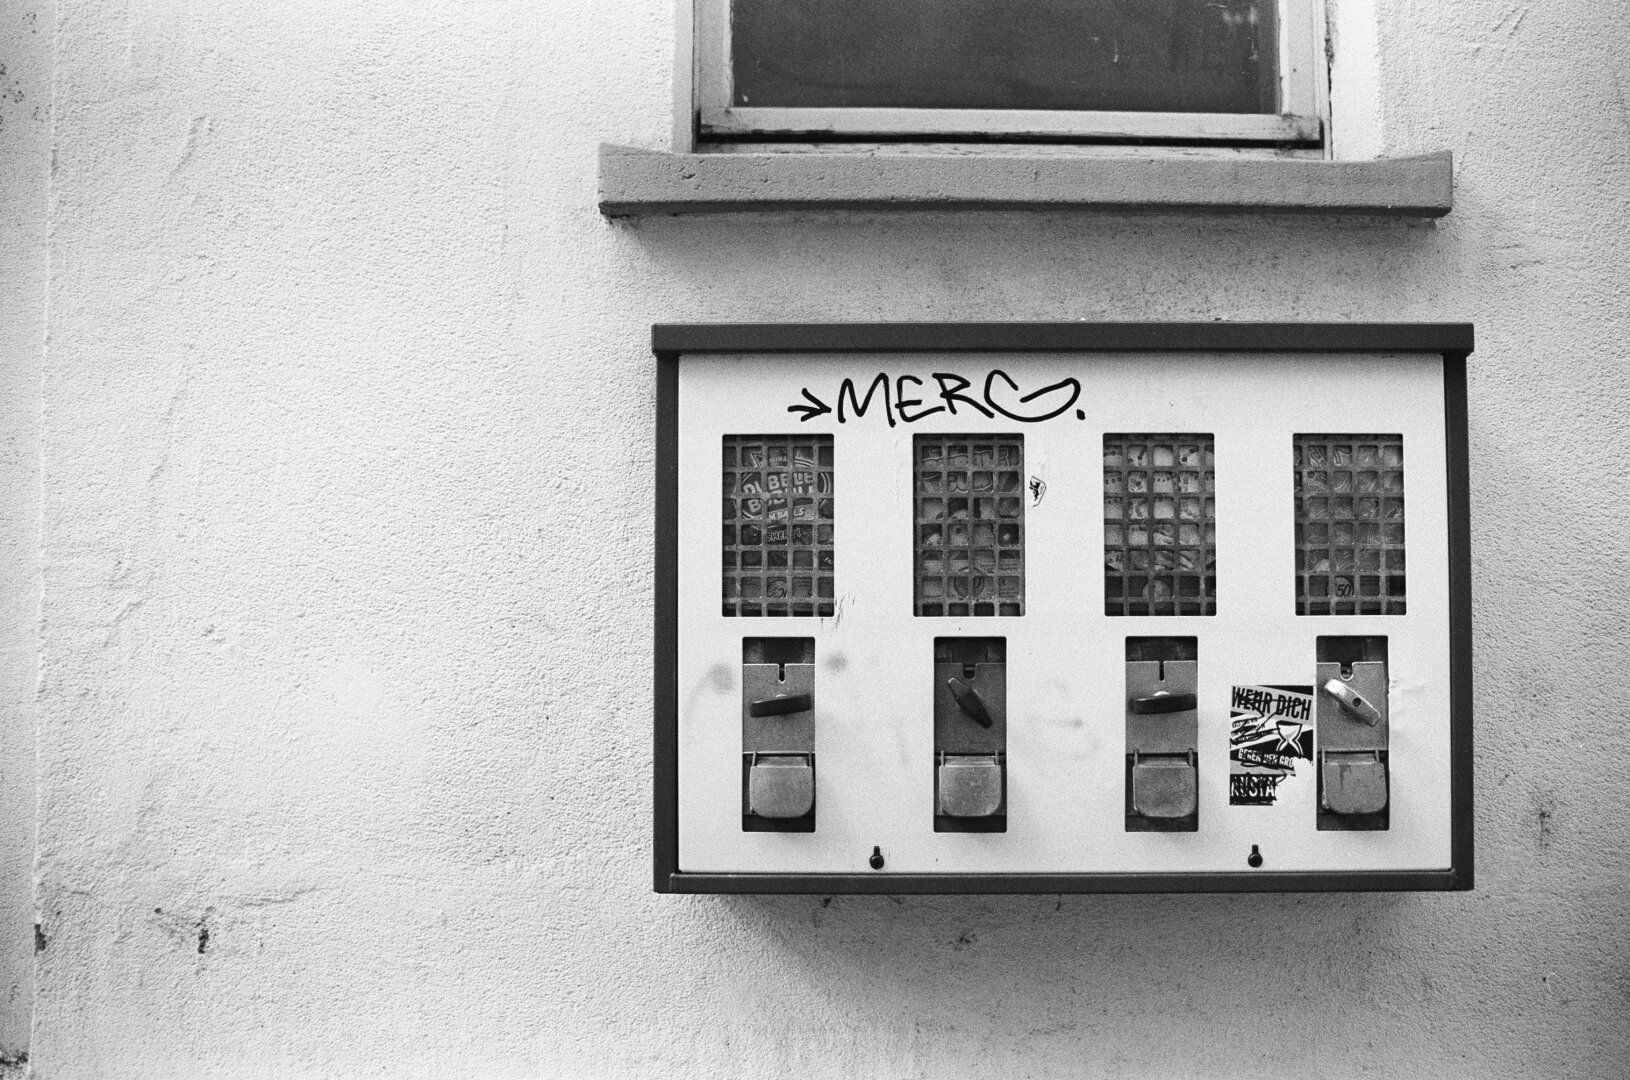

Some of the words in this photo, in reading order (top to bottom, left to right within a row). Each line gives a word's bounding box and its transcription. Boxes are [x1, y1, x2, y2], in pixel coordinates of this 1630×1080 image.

[777, 507, 805, 519] BALS
[1335, 583, 1352, 598] 50
[1232, 685, 1273, 714] WEHR
[1275, 693, 1312, 720] DICH
